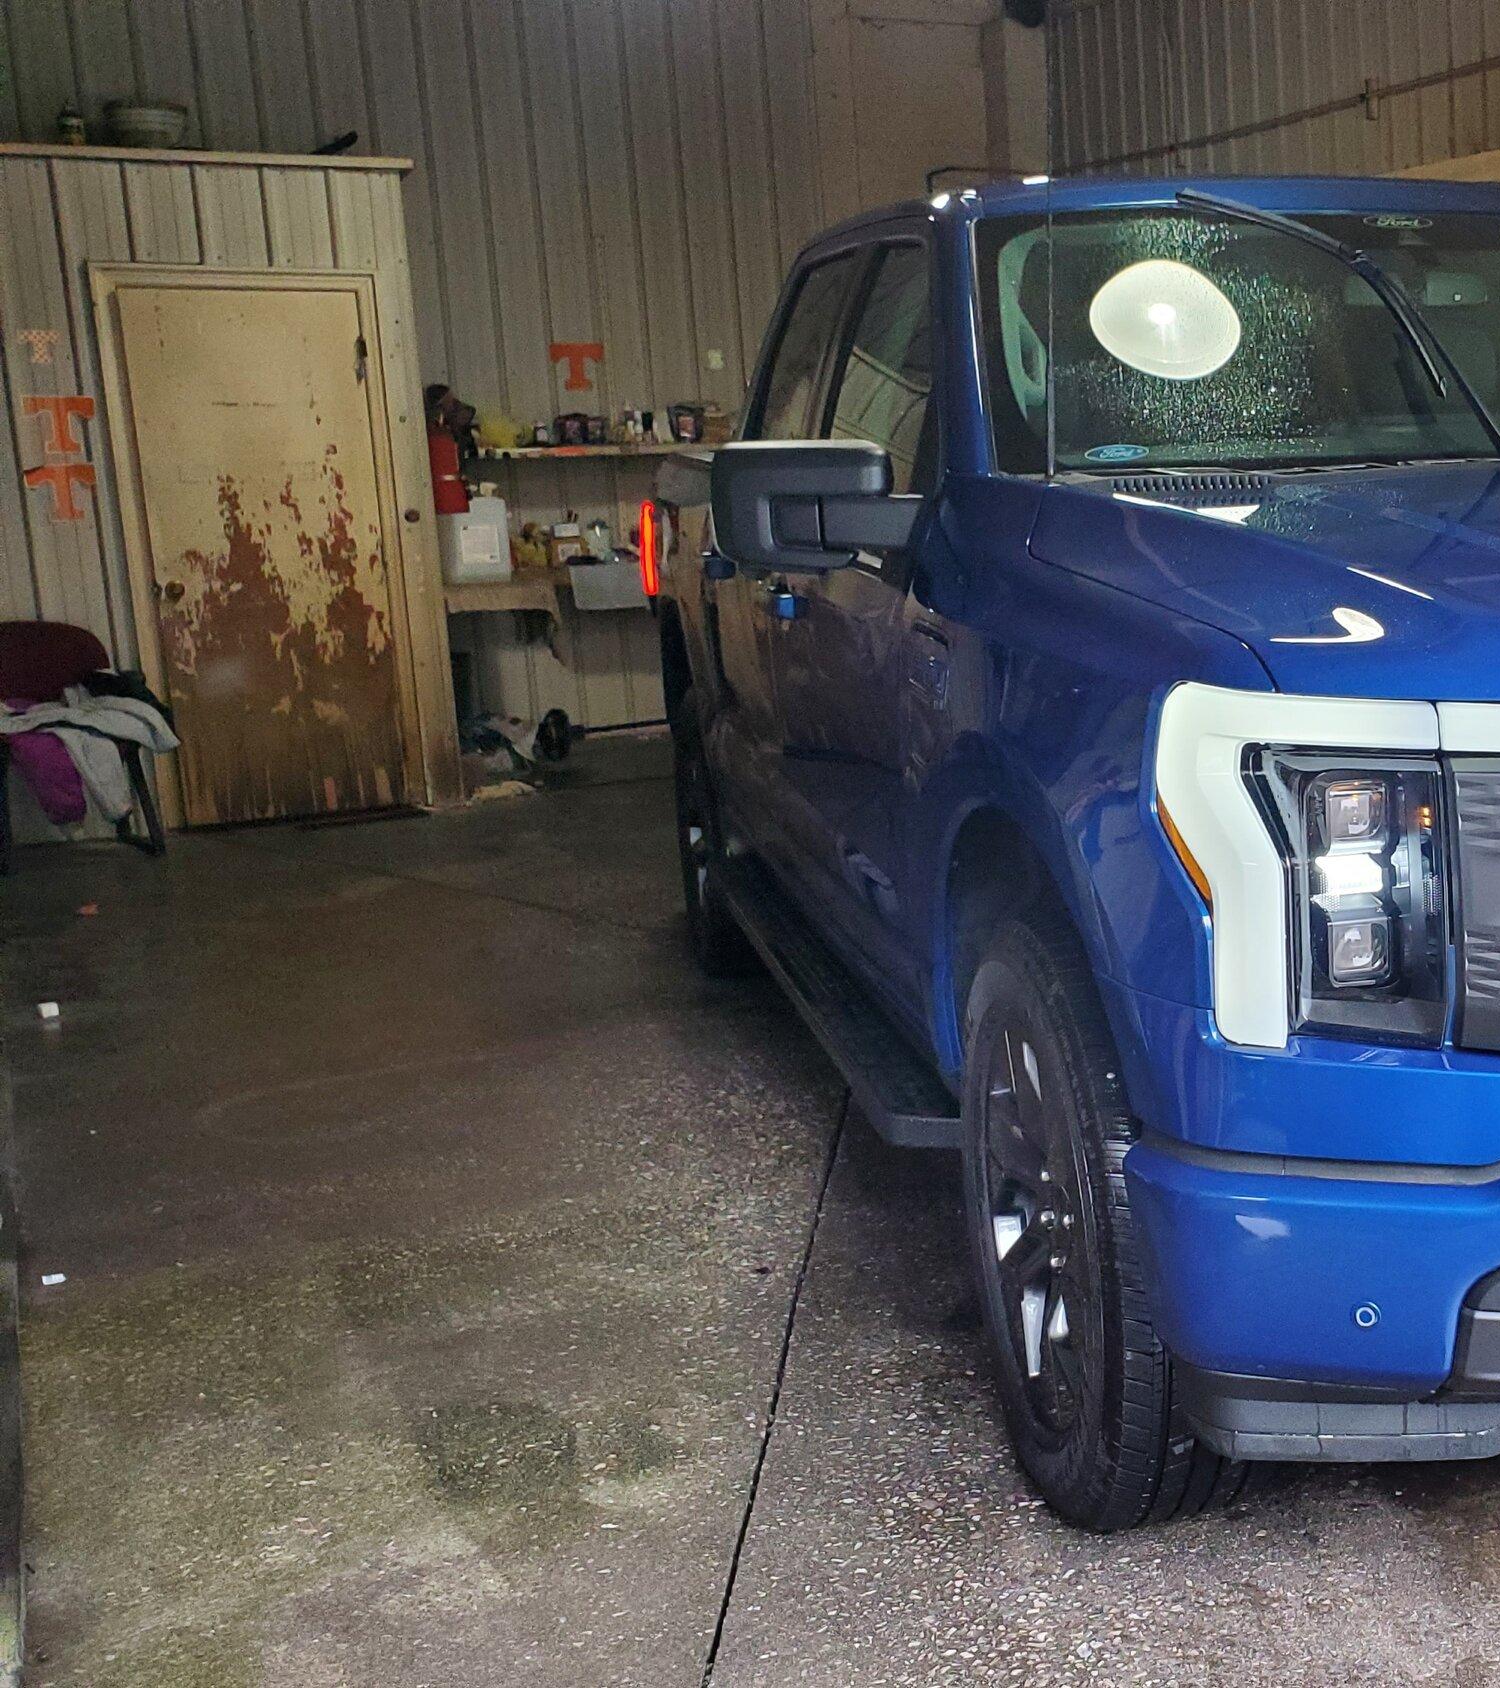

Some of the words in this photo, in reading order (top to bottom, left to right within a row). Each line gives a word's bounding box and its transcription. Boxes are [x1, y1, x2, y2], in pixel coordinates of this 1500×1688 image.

[1377, 215, 1419, 228] Ford
[18, 330, 60, 364] T
[549, 343, 604, 391] T
[22, 396, 95, 454] T
[1100, 447, 1133, 459] Ford
[24, 463, 97, 521] T
